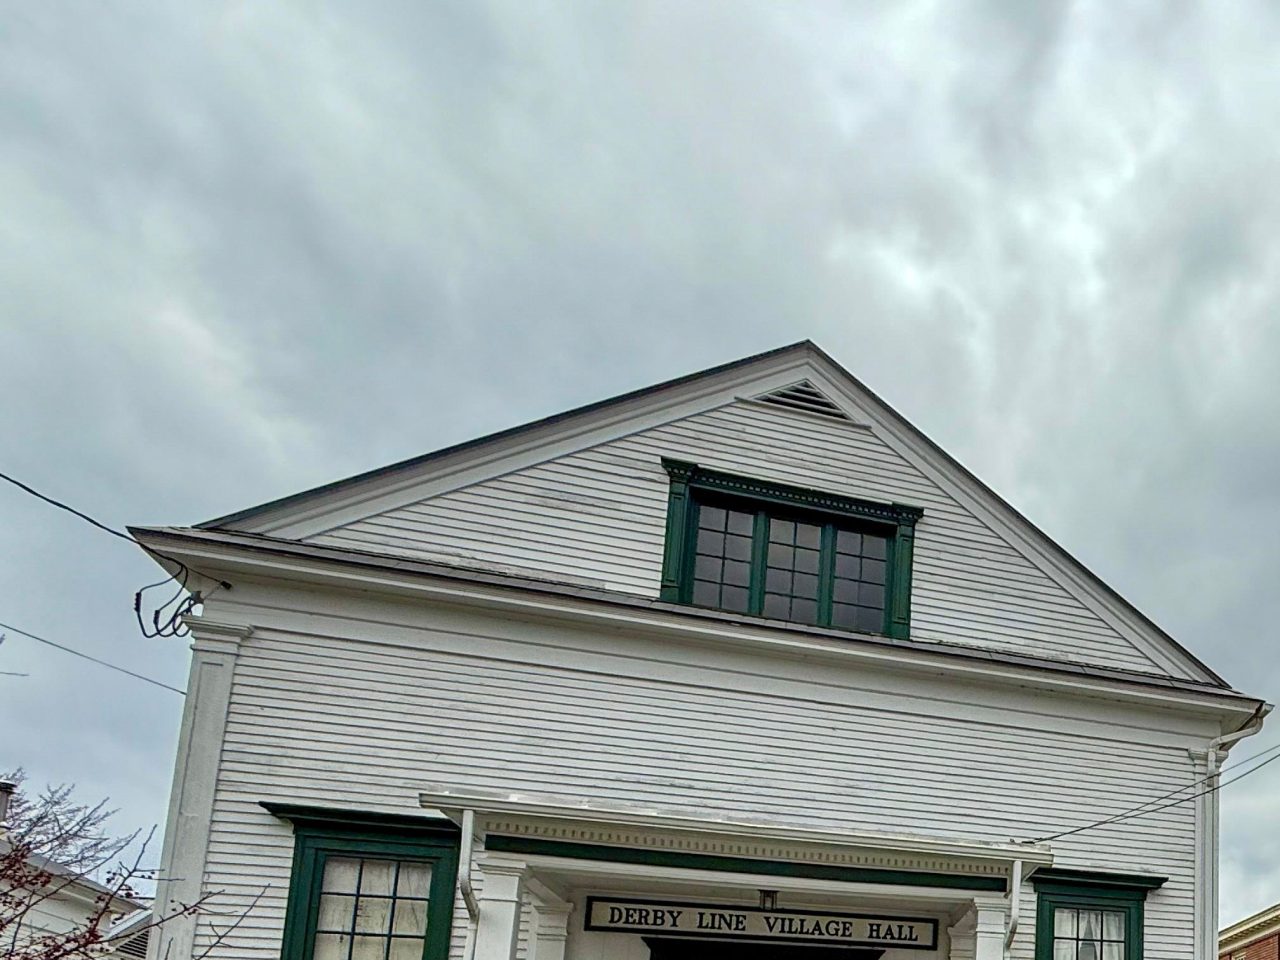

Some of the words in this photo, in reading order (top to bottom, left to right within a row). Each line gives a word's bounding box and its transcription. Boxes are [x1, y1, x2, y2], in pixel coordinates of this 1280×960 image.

[608, 905, 682, 927] DERBY
[696, 912, 747, 931] LINE
[763, 916, 853, 938] VILLAGE
[867, 924, 918, 942] HALL
